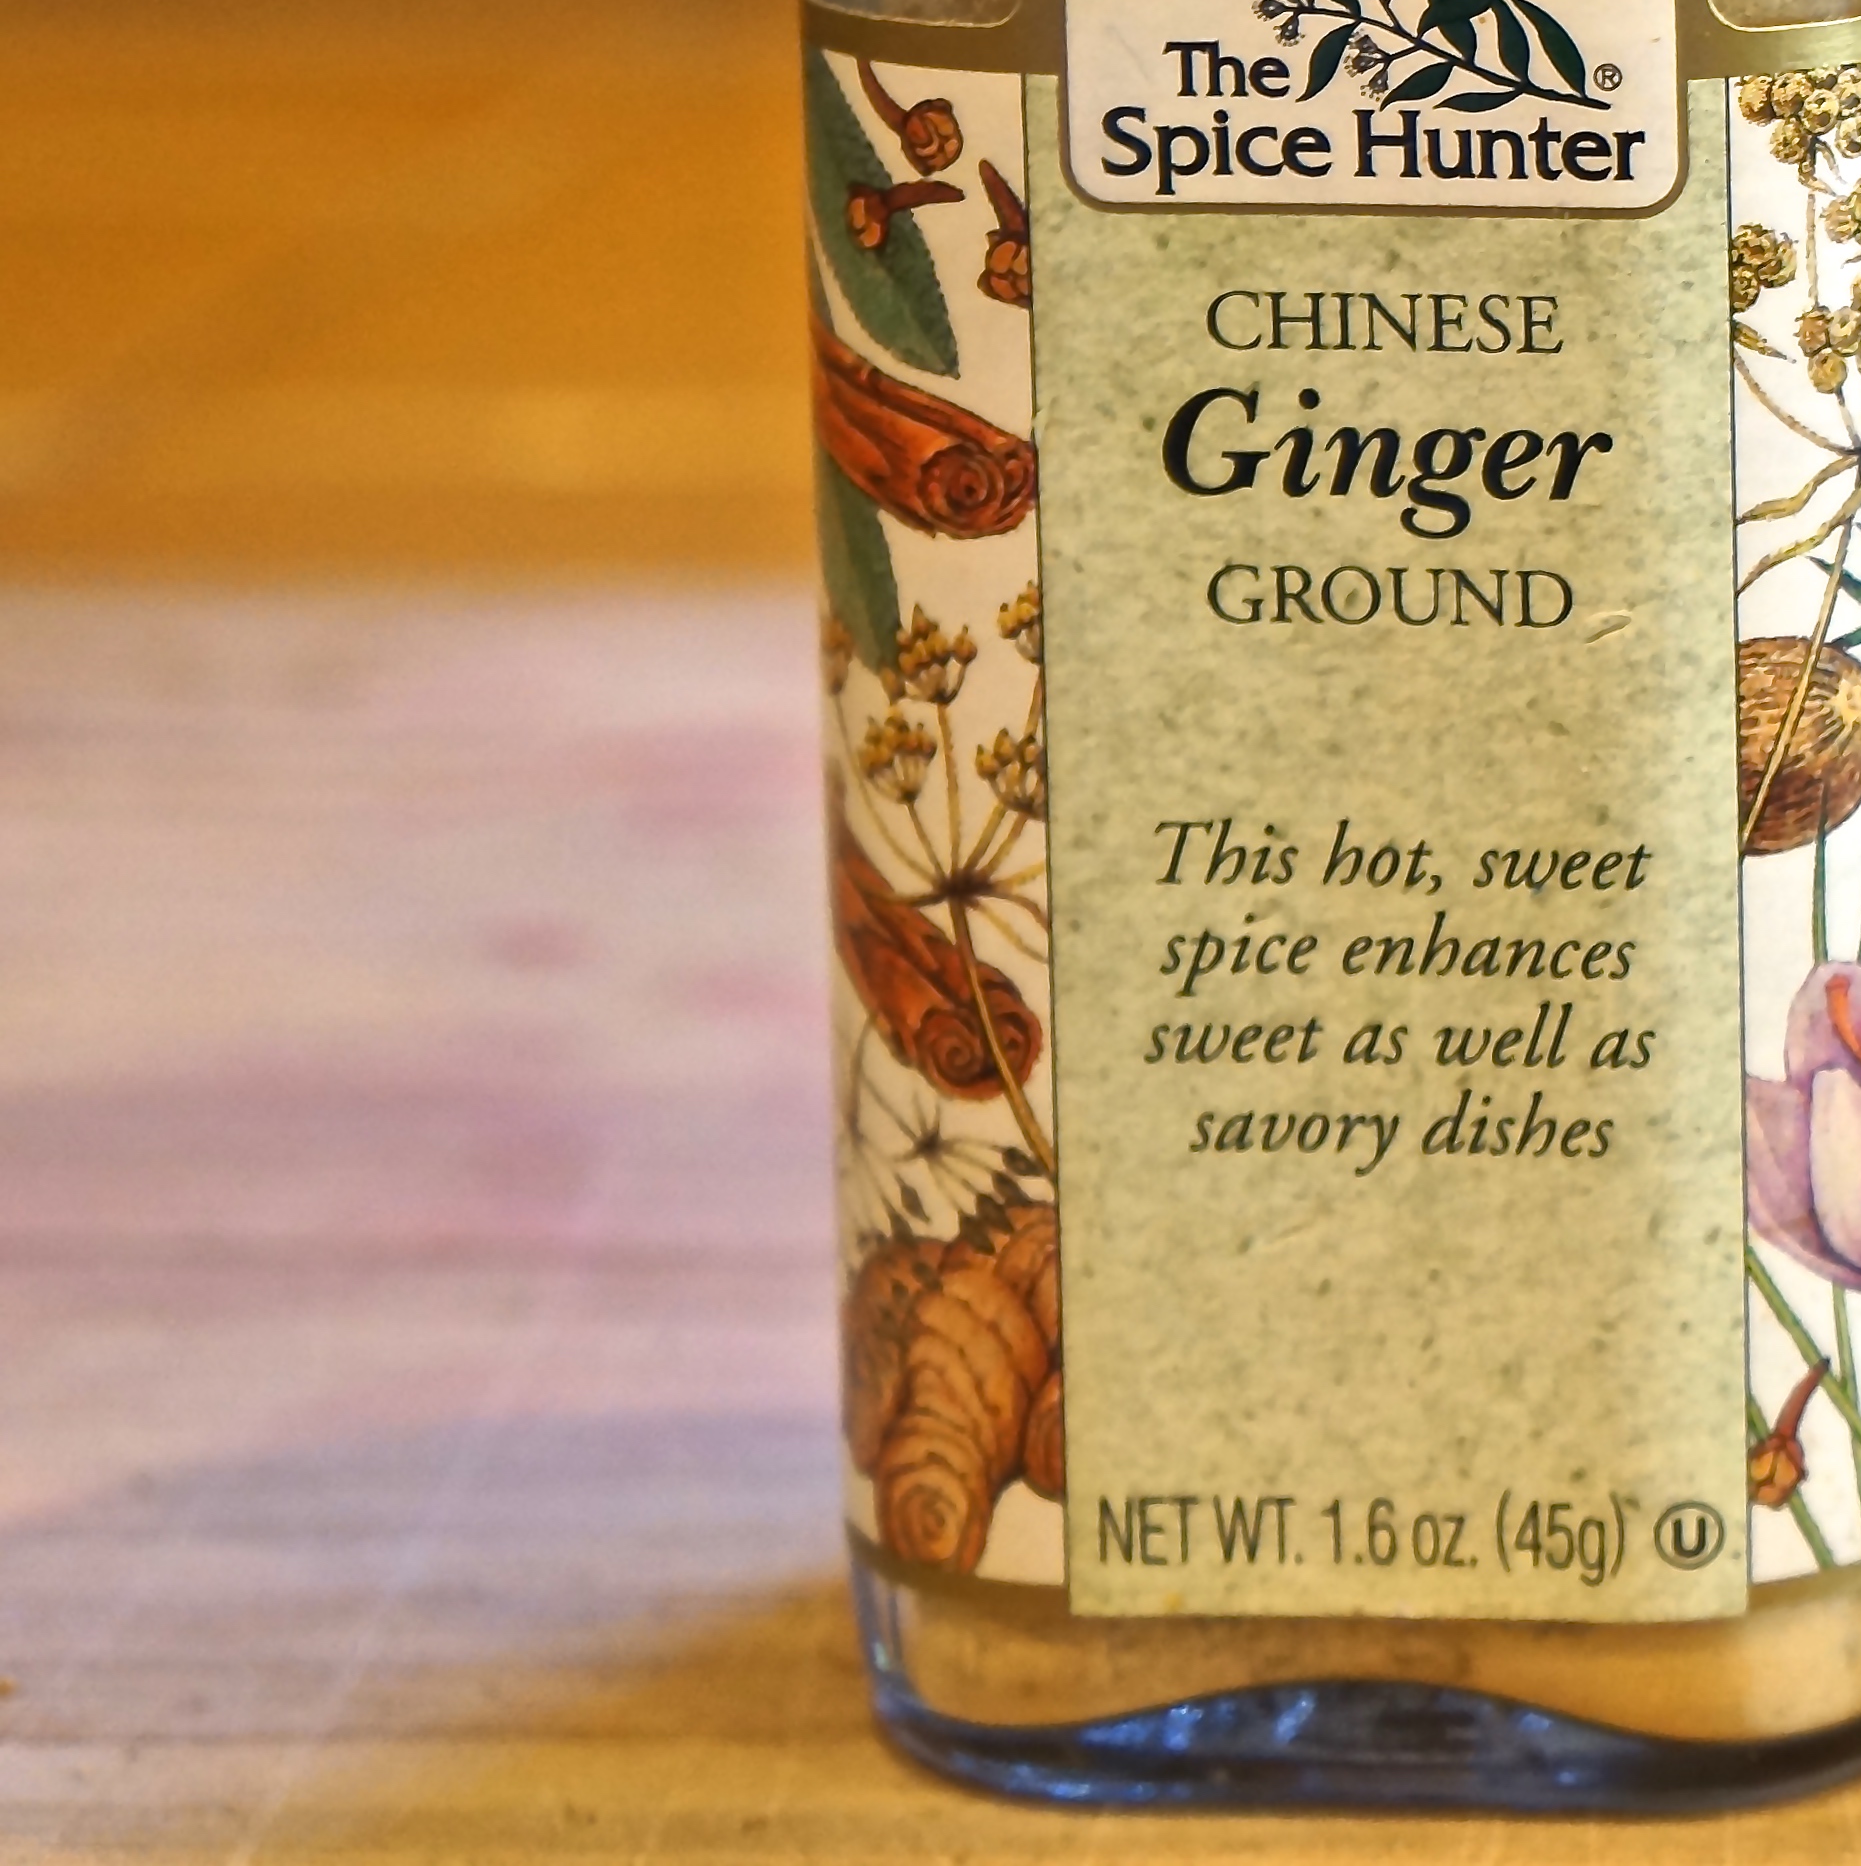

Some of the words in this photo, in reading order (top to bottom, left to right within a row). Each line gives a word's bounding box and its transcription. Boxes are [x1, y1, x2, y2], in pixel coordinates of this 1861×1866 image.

[1164, 40, 1291, 99] The
[1100, 106, 1331, 196] Spice
[1352, 108, 1645, 182] Hunter
[1206, 290, 1564, 354] CHINESE
[1161, 386, 1614, 539] Ginger
[1206, 564, 1573, 628] GROUND
[1154, 817, 1300, 887] This
[1322, 817, 1444, 895] hot,
[1471, 843, 1652, 892] sweet
[1159, 912, 1318, 998] spice
[1342, 910, 1636, 981] enhances
[1143, 1016, 1324, 1065] sweet
[1343, 1022, 1409, 1065] as
[1434, 1000, 1574, 1069] well
[1590, 1027, 1657, 1070] as
[1188, 1110, 1400, 1177] savory
[1421, 1088, 1614, 1158] dishes
[1097, 1494, 1199, 1566] NET
[1213, 1494, 1303, 1566] WT.
[1321, 1496, 1398, 1567] 1.6
[1411, 1512, 1479, 1567] oz.
[1496, 1489, 1625, 1588] (45g)
